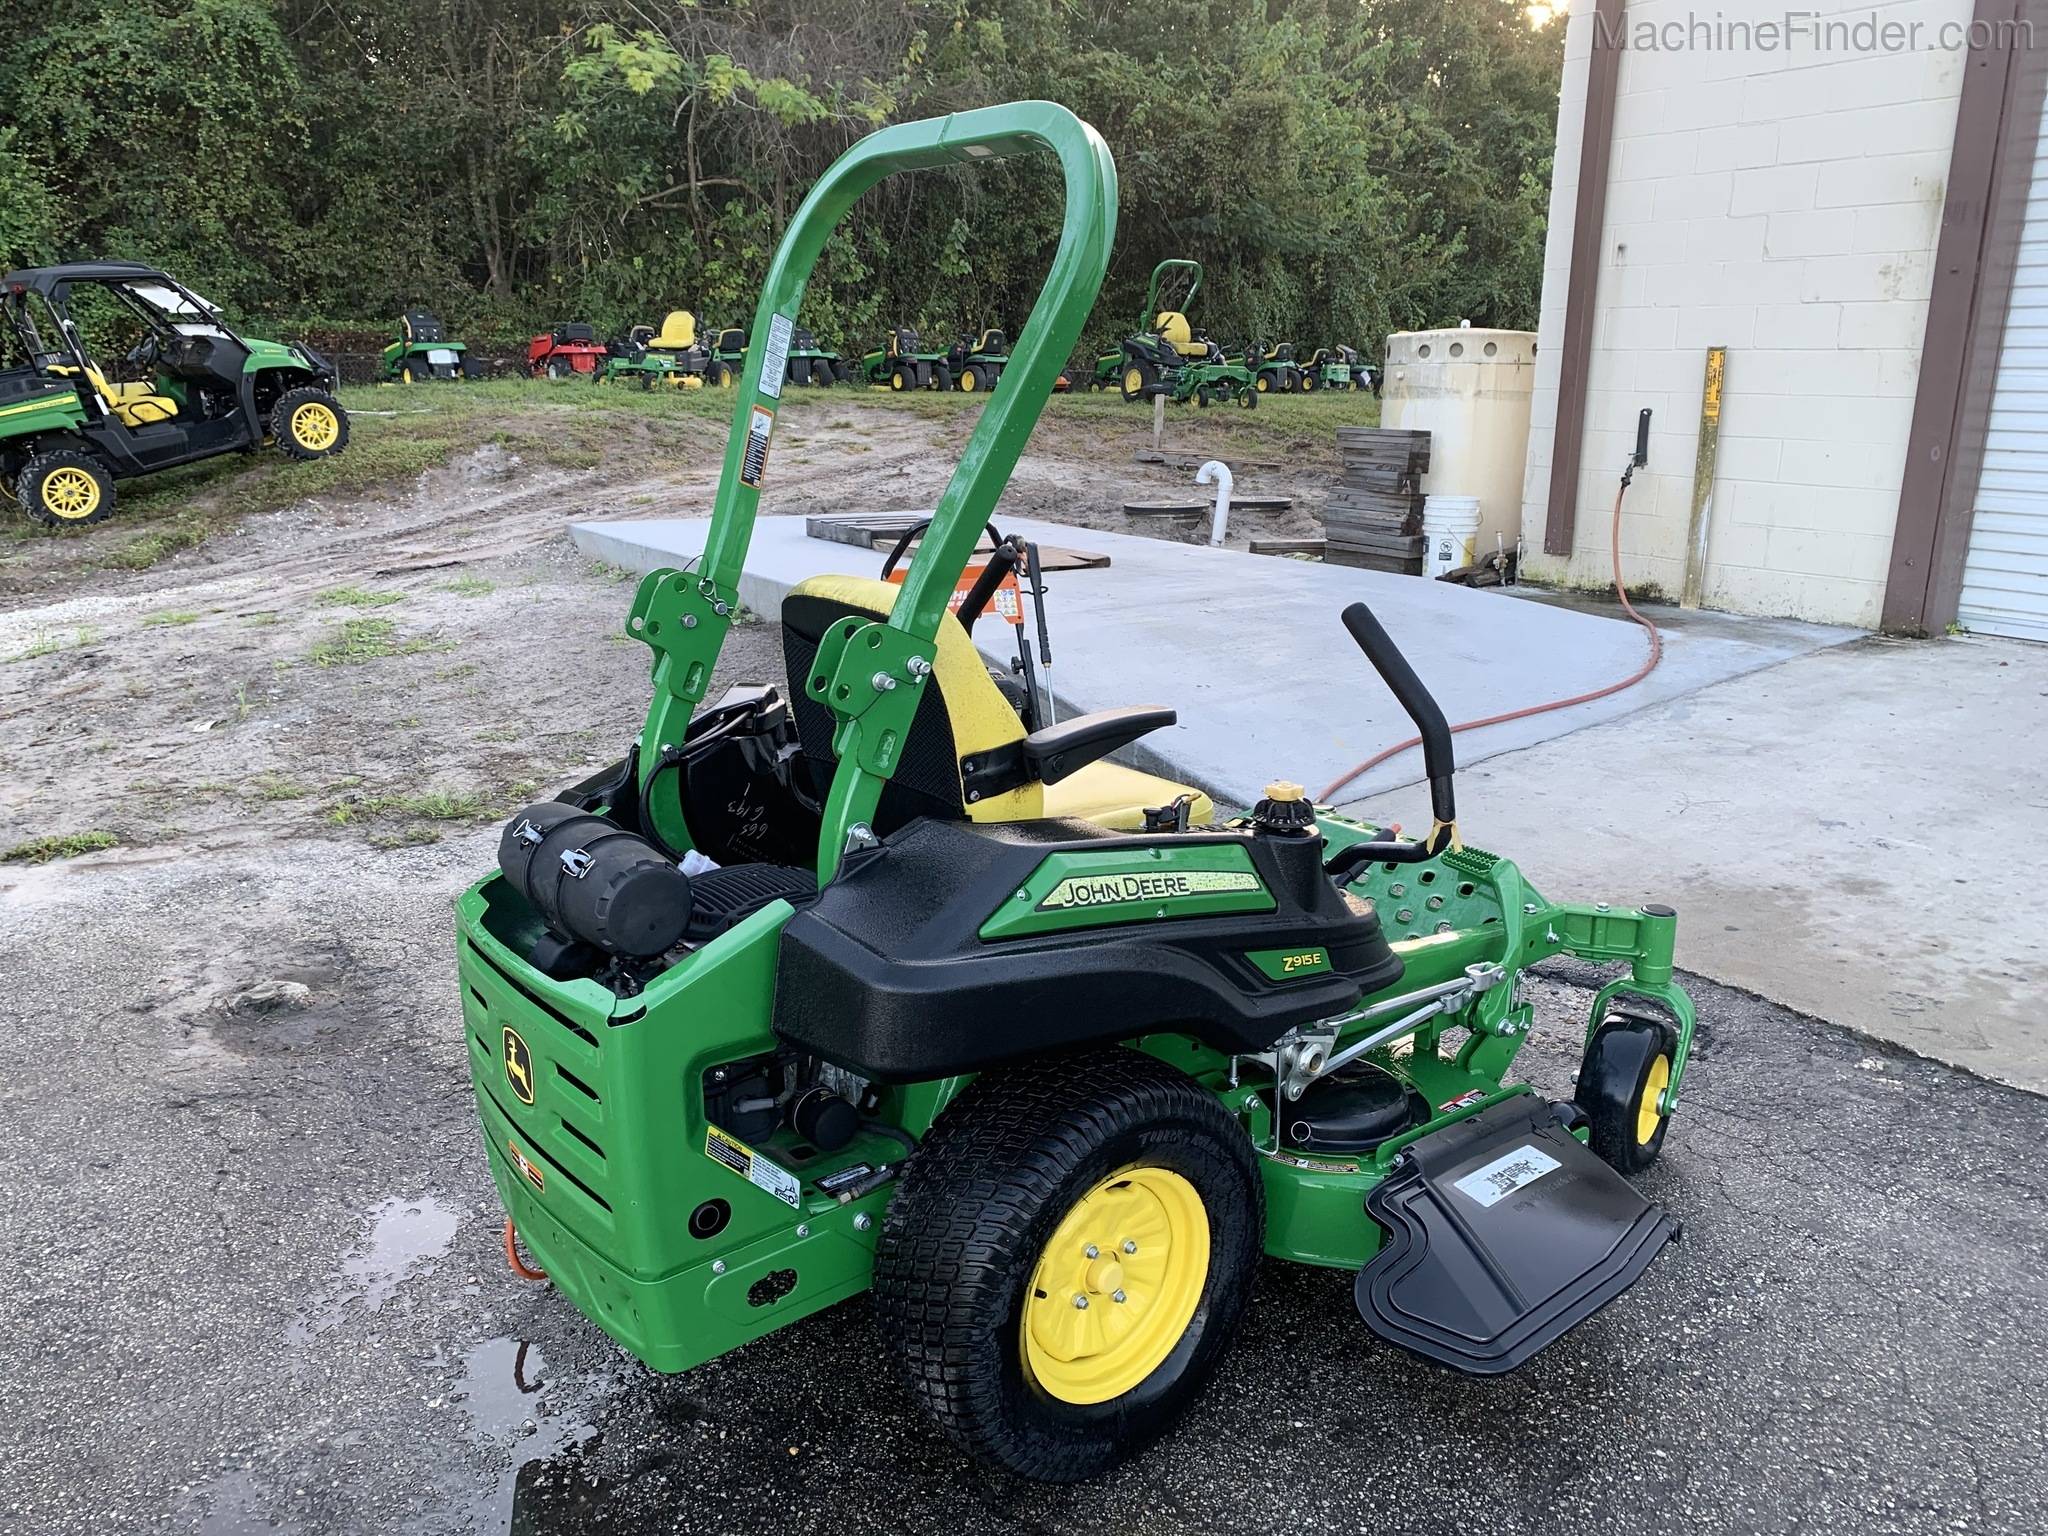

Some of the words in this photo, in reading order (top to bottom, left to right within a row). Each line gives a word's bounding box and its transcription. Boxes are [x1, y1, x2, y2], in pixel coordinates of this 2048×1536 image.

[1064, 882, 1121, 903] JOHN
[1123, 877, 1187, 898] DEERE
[1282, 953, 1322, 971] Z915E
